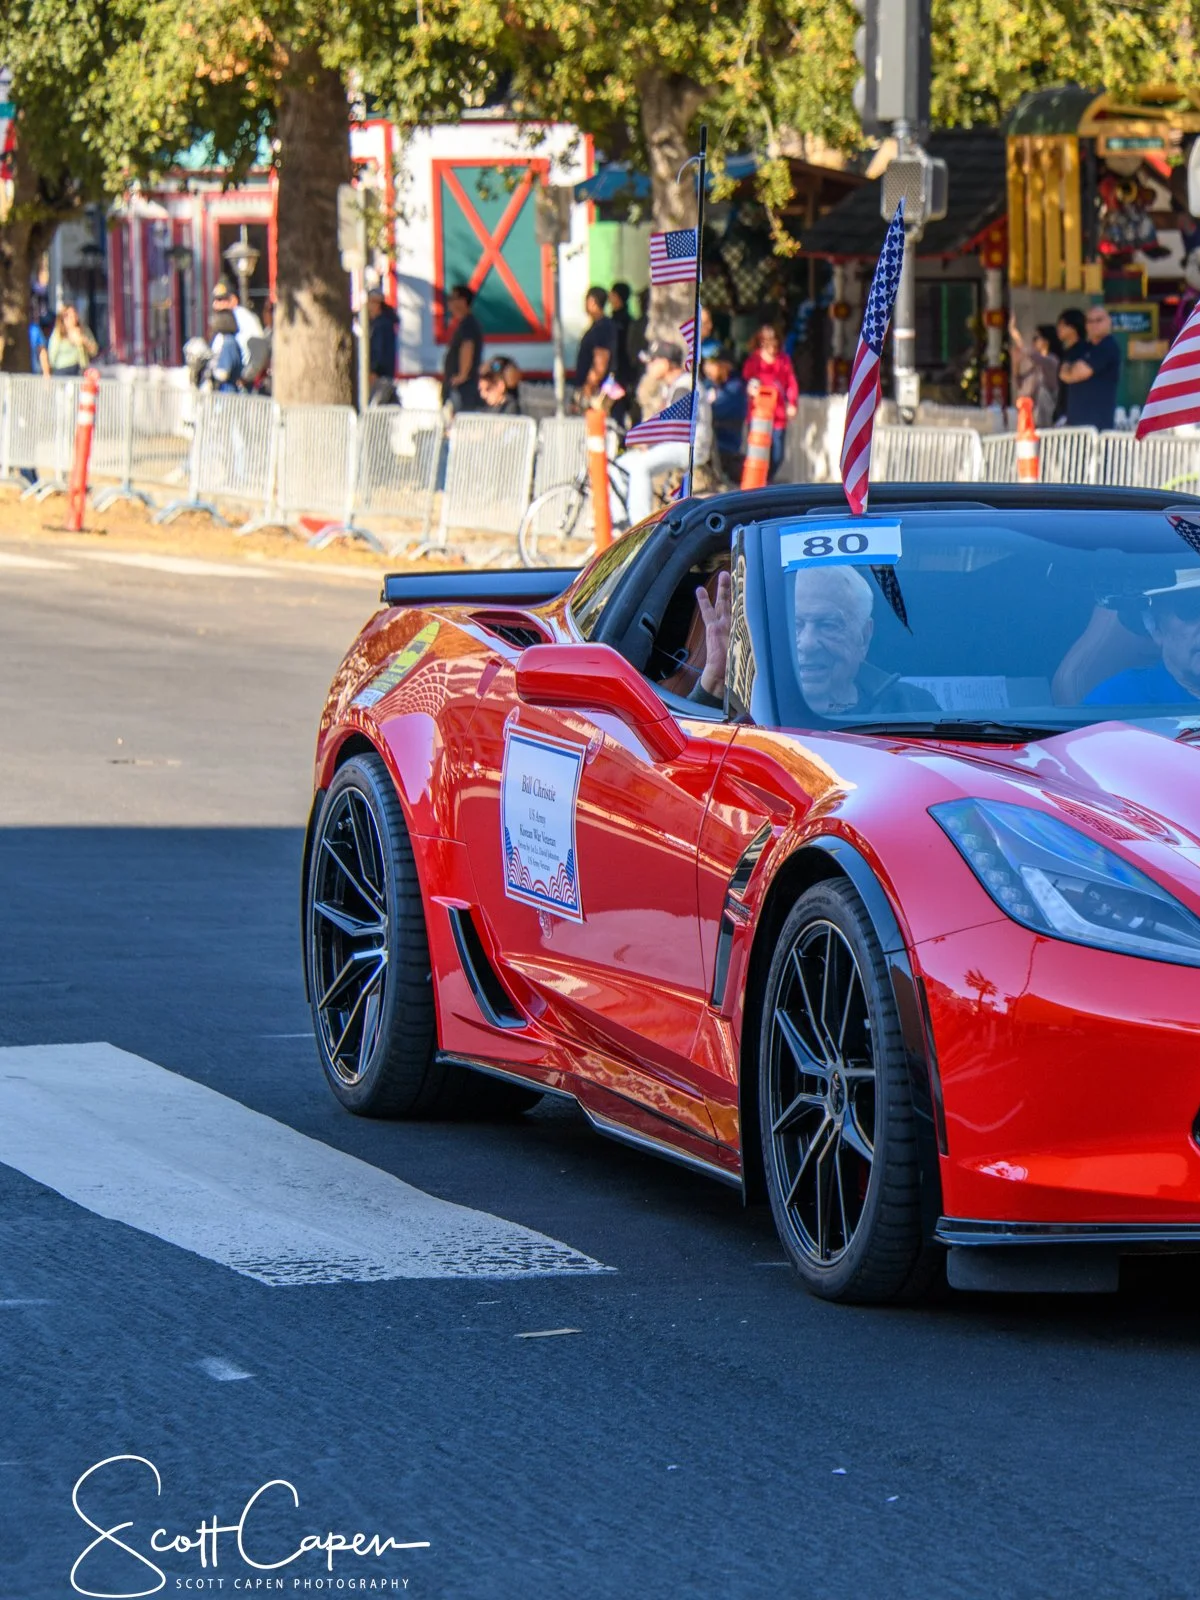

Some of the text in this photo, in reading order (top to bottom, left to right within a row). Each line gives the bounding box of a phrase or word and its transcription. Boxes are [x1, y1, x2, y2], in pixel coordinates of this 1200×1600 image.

[802, 533, 869, 557] 80
[521, 774, 556, 802] Bill Christie
[528, 807, 546, 828] US Army
[519, 823, 556, 847] Korean War Veteran
